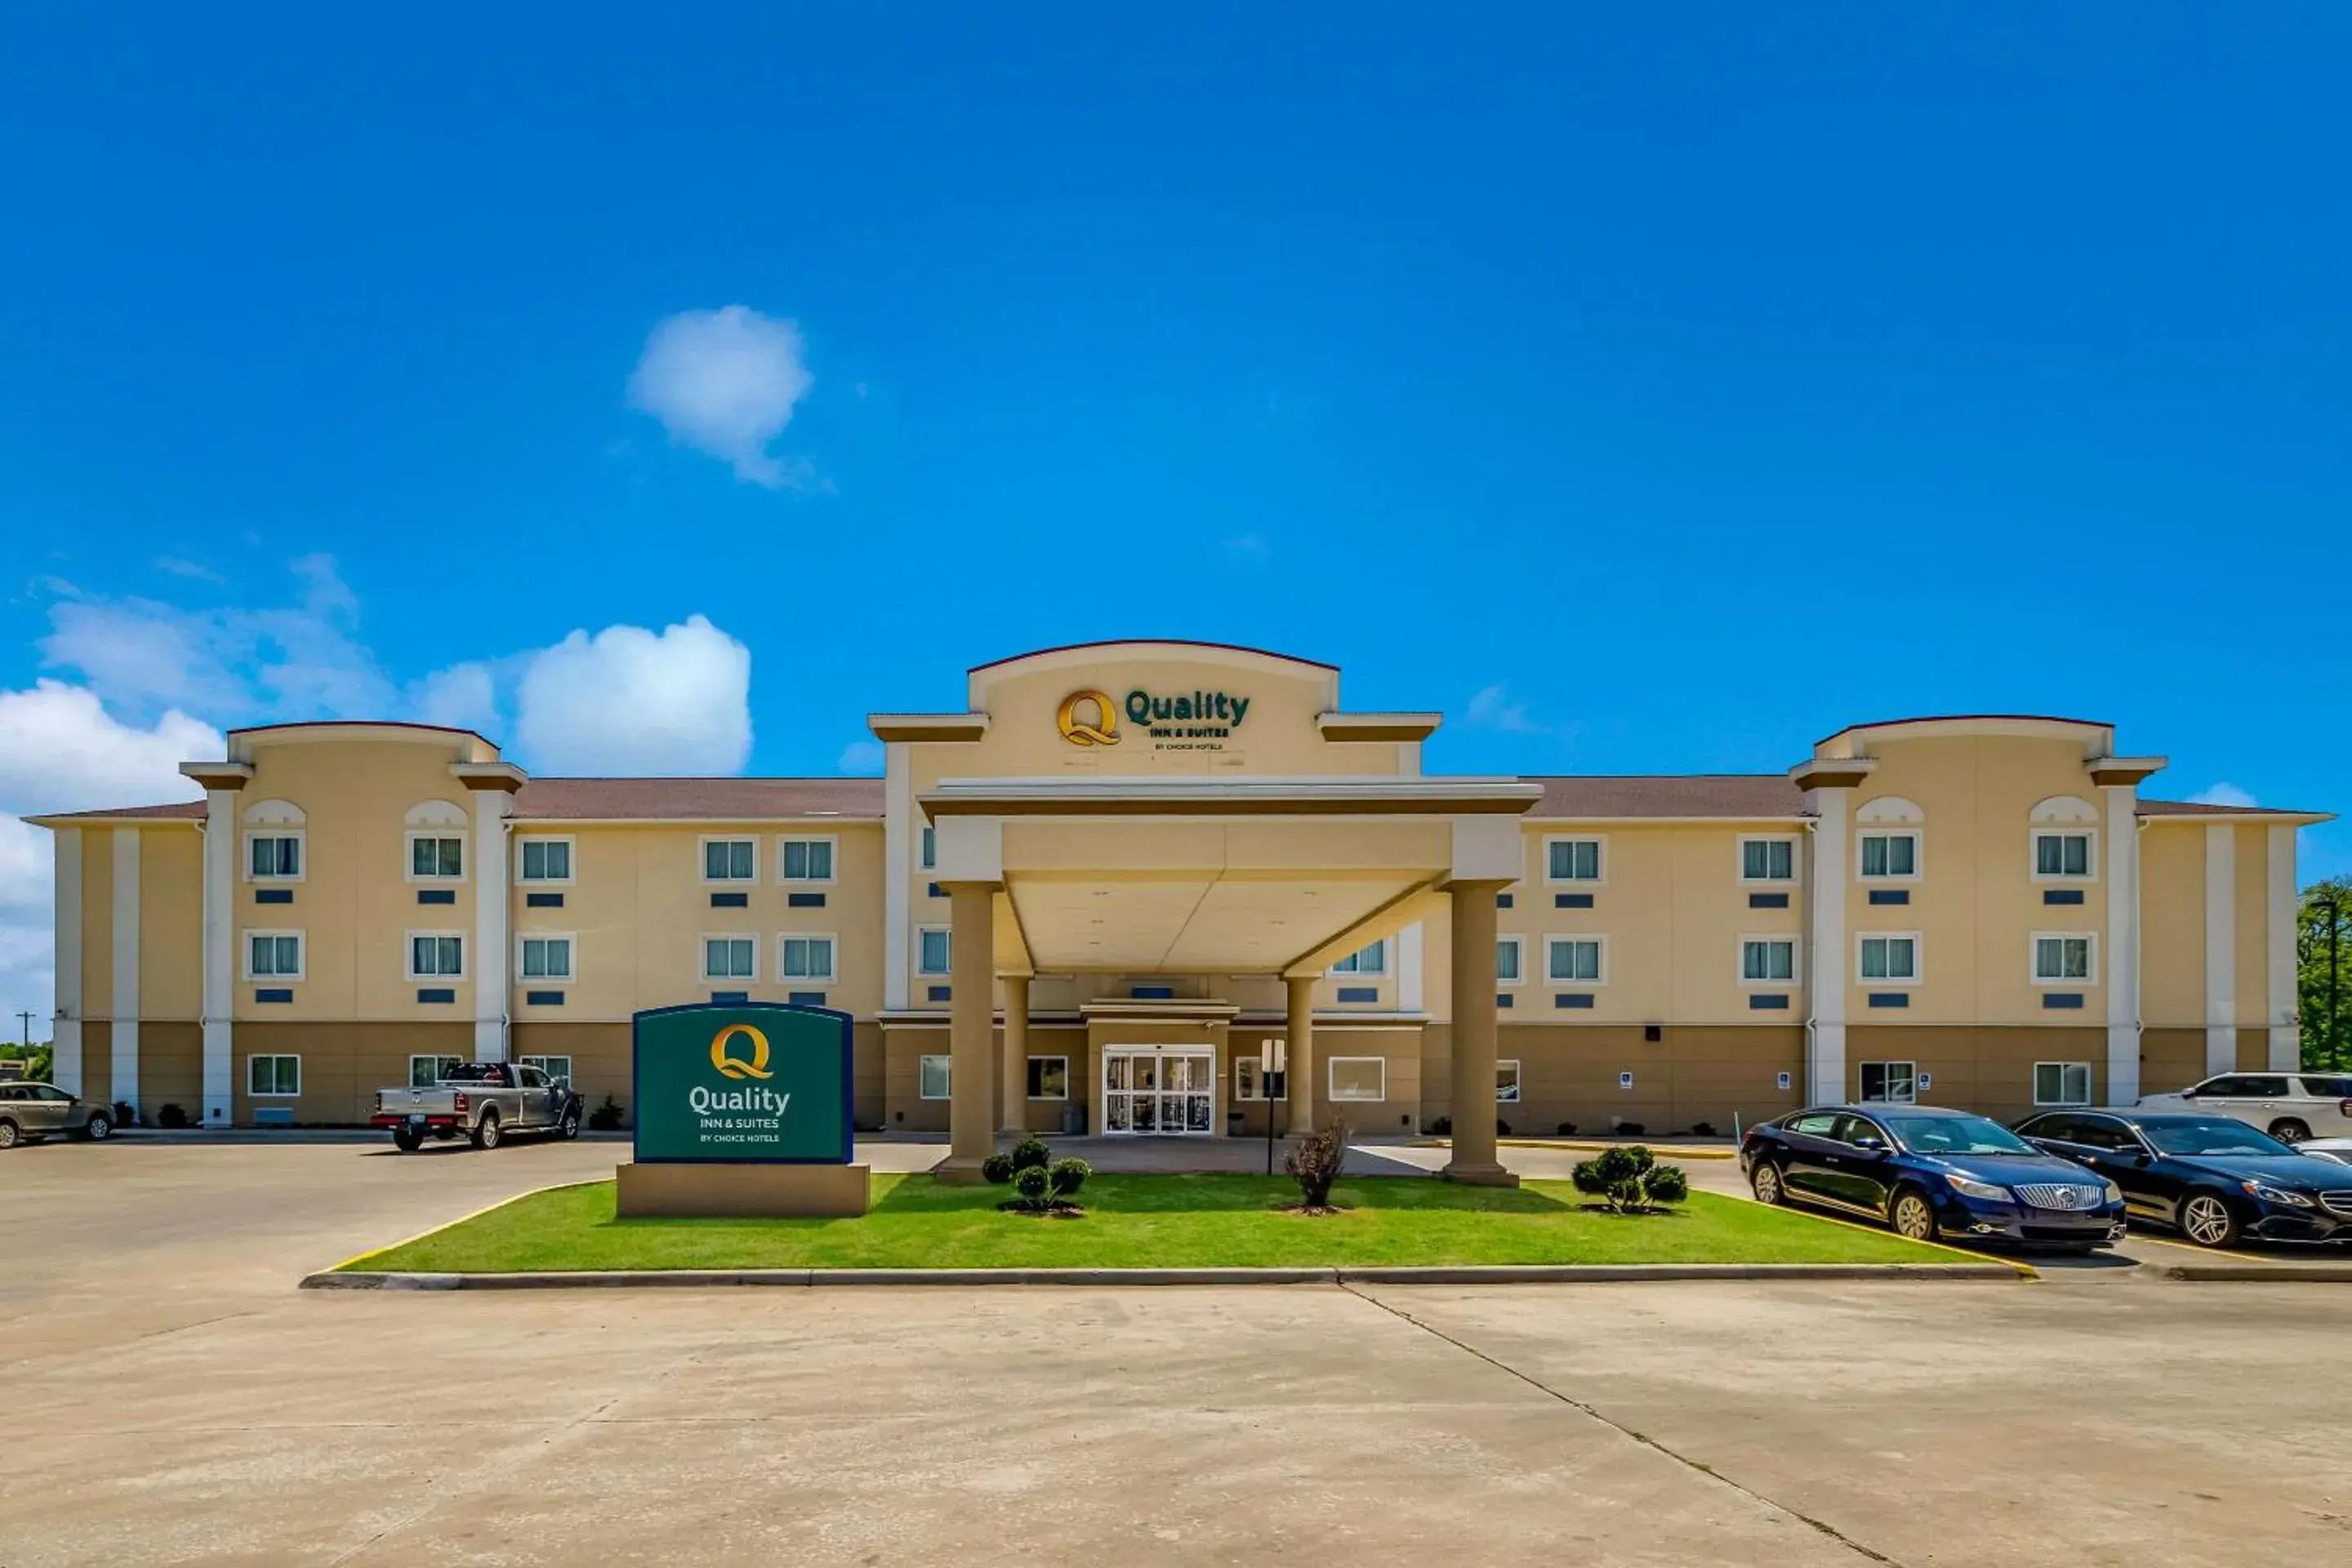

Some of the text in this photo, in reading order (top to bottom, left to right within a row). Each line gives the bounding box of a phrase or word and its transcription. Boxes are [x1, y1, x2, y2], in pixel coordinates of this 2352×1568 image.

[1125, 690, 1250, 727] Quality
[1150, 728, 1172, 737] INN
[1187, 728, 1229, 737] SUITES
[689, 1086, 790, 1116] Quality
[701, 1119, 778, 1128] INN & SUITES
